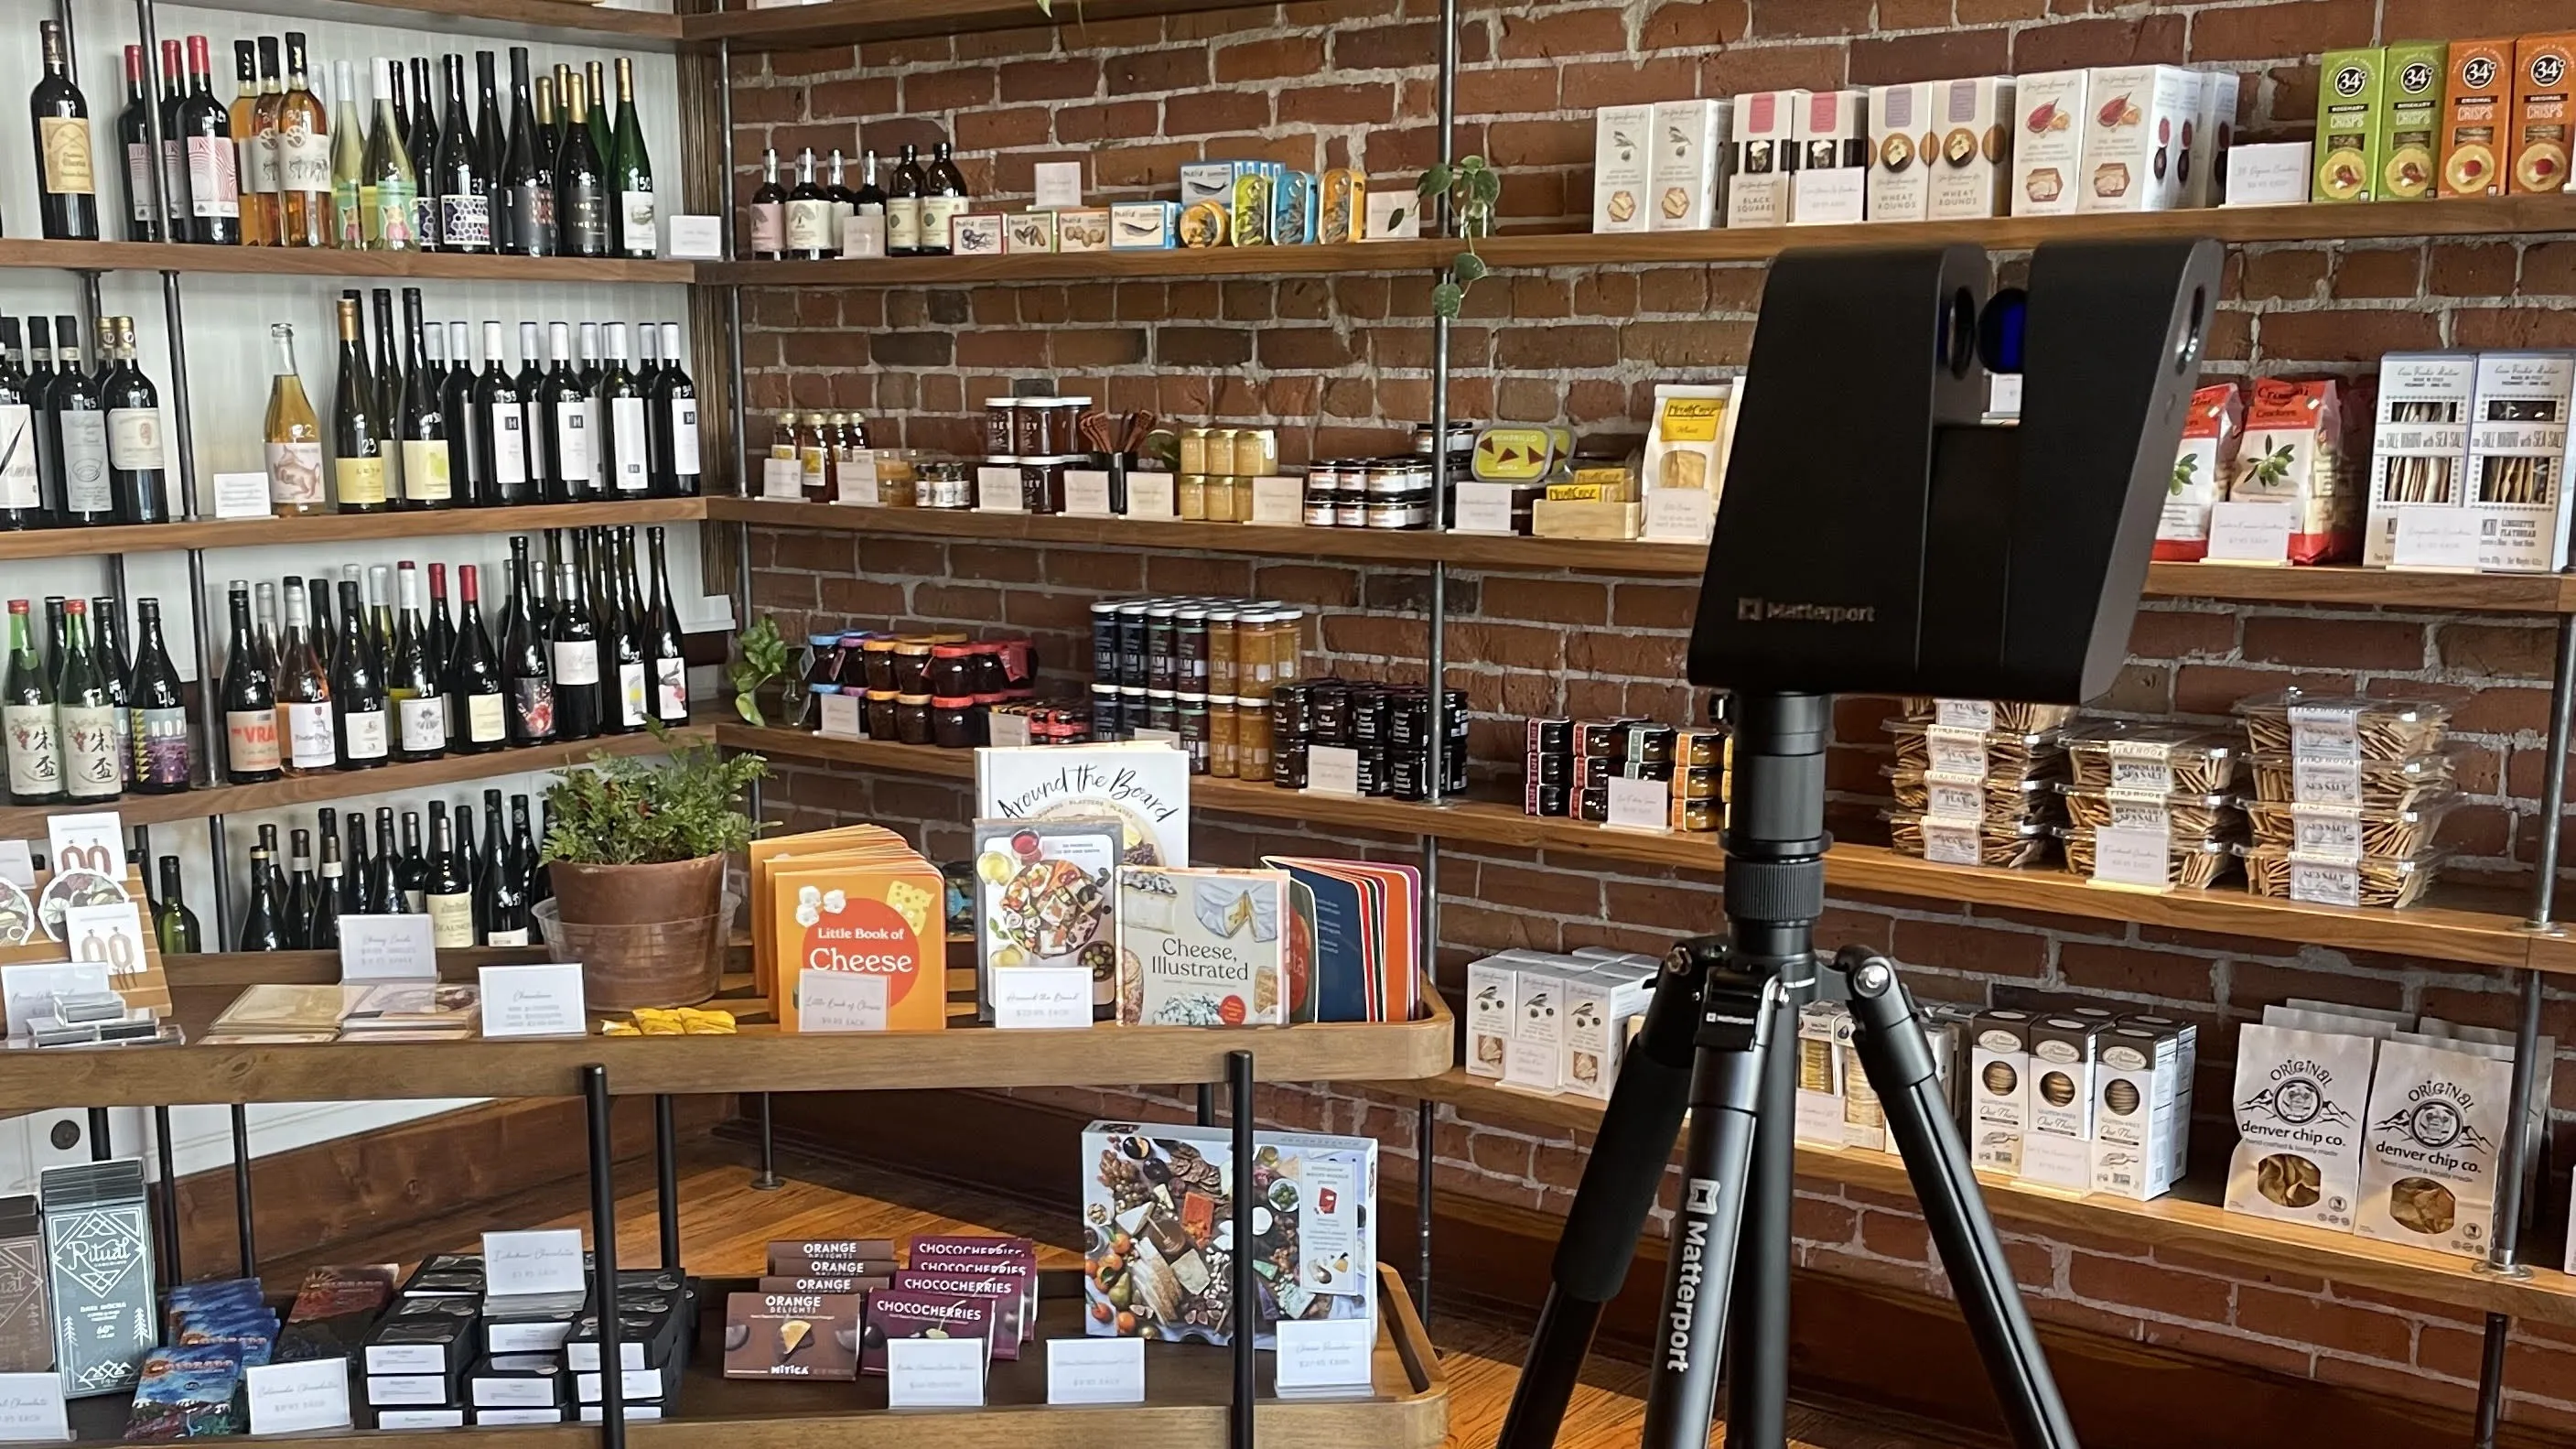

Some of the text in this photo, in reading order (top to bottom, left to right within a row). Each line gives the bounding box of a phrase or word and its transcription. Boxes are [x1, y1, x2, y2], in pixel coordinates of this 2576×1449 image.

[2396, 111, 2430, 125] CRISPS
[2457, 105, 2493, 122] CRISPS
[2527, 103, 2563, 119] CRISPS
[2330, 114, 2365, 128] CRISPS
[1881, 193, 1913, 201] WHEAT
[1942, 189, 1974, 198] WHEAT
[1737, 203, 1776, 212] SQUARES
[1878, 201, 1916, 210] ROUNDS
[1938, 198, 1977, 206] ROUNDS
[2435, 431, 2448, 448] SEA
[2450, 431, 2465, 449] SALT
[2533, 430, 2546, 448] SEA
[2548, 431, 2565, 449] SALT
[1767, 601, 1875, 624] Matterport
[2112, 745, 2164, 757] FIREHOOK
[2118, 763, 2167, 773] ROSEMARY
[997, 763, 1180, 824] Around the Board
[817, 927, 905, 941] Little Book of
[1162, 937, 1238, 962] Cheese,
[809, 947, 913, 973] Cheese
[1151, 957, 1249, 981] Illustrated
[2270, 1059, 2333, 1089] ORIGINAL
[2408, 1080, 2475, 1114] ORIGINAL
[2241, 1119, 2346, 1147] denver chip co.
[2376, 1141, 2482, 1173] denver chip co.
[66, 1237, 131, 1271] Ritual
[803, 1242, 857, 1254] ORANGE
[811, 1261, 864, 1273] ORANGE
[796, 1279, 851, 1291] ORANGE
[904, 1278, 1012, 1294] CHOCOCHERRIES
[765, 1295, 822, 1307] ORANGE
[1667, 1220, 1708, 1373] Matterport
[101, 1302, 127, 1310] MOCHA
[770, 1306, 816, 1314] DELIGHTS
[877, 1300, 982, 1321] CHOCOCHERRIES
